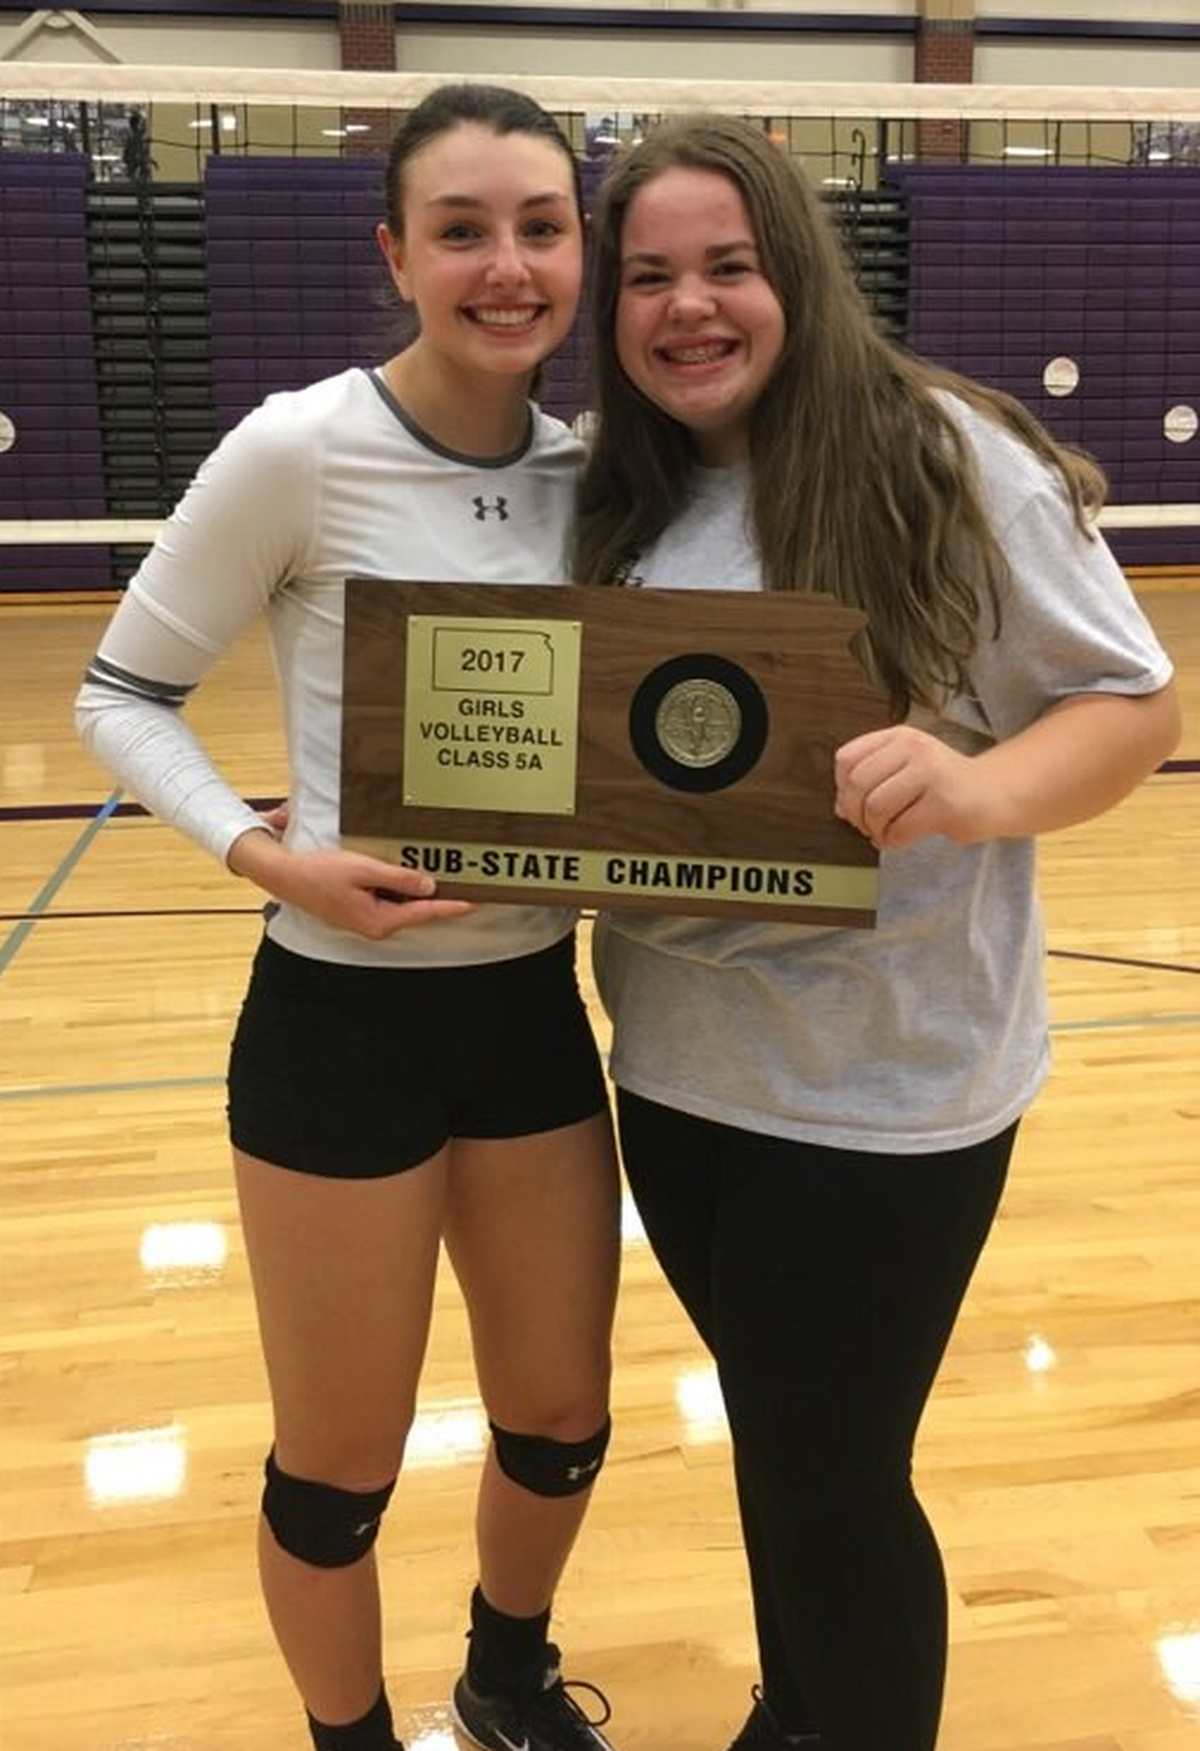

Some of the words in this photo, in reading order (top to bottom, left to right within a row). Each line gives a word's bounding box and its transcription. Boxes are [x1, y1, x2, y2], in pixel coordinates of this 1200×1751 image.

[461, 648, 525, 673] 2017
[458, 698, 525, 718] GIRLS
[419, 722, 563, 746] VOLLEYBALL
[437, 748, 509, 769] CLASS
[515, 752, 543, 770] 5A
[401, 845, 579, 882] SUB-STATE
[607, 858, 814, 896] CHAMPIONS
